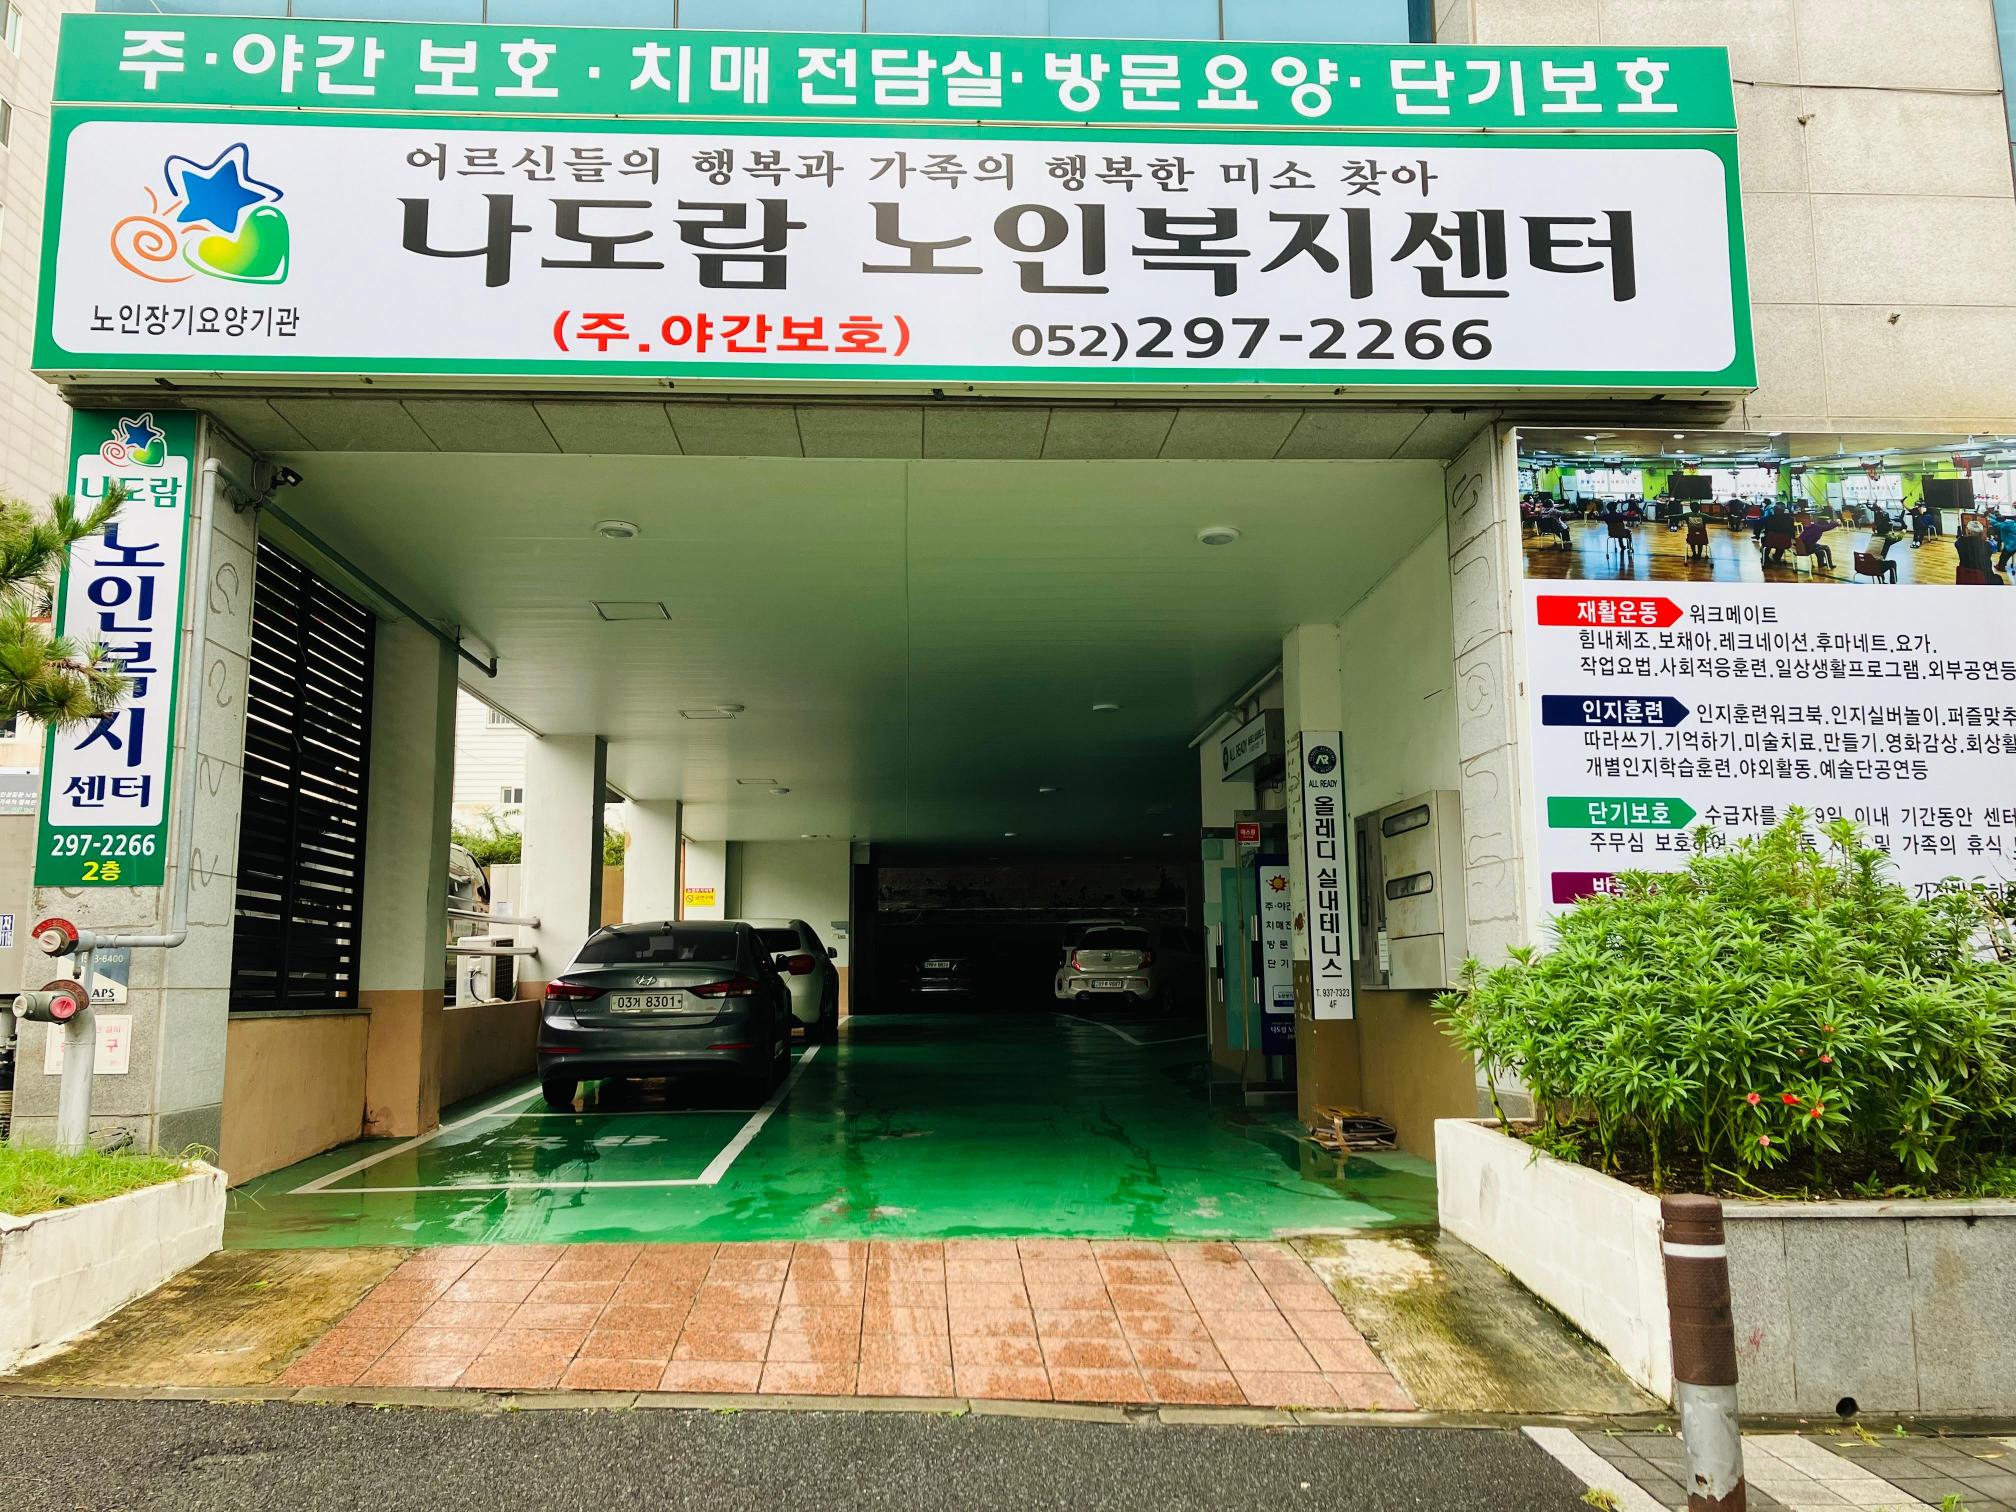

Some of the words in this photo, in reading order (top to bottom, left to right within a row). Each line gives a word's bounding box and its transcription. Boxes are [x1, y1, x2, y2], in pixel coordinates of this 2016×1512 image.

[414, 39, 559, 97] 보호
[1389, 57, 1679, 117] 단기보호
[405, 142, 660, 185] 어르신들의
[692, 148, 845, 188] 행복과
[869, 152, 1014, 190] 가족의
[1045, 154, 1195, 194] 행복한
[1219, 157, 1316, 195] 미소
[1340, 158, 1439, 198] 찾아
[396, 194, 808, 290] 나도람
[862, 201, 1637, 302] 노인복지센터
[90, 303, 300, 337] 노인장기요양기관
[552, 309, 911, 357] (주.야간보호)
[1011, 315, 1494, 362] 052)297-2266
[81, 476, 182, 508] 나도람
[1577, 599, 1659, 625] 재활운동
[1689, 603, 1779, 625] 워크메이트
[1582, 699, 1664, 724] 인지훈련
[62, 774, 151, 808] 센터
[1309, 779, 1319, 788] ALL
[1320, 779, 1338, 788] READY
[1588, 801, 1672, 825] 단기보호
[1704, 804, 1777, 826] 수급자를
[1814, 805, 1843, 825] 9일
[1854, 805, 1890, 827] 이내
[1900, 806, 1973, 828] 기간동안
[1313, 795, 1337, 861] 올레디
[51, 834, 156, 857] 297-2266
[1589, 832, 1645, 853] 주무심
[1902, 834, 1957, 855] 가족의
[1967, 835, 2002, 856] 휴식
[81, 861, 121, 881] 2층
[1316, 868, 1343, 979] 실내테니스
[646, 996, 675, 1008] 8301
[1323, 988, 1350, 997] 937-7323
[1329, 1000, 1337, 1008] 4F
